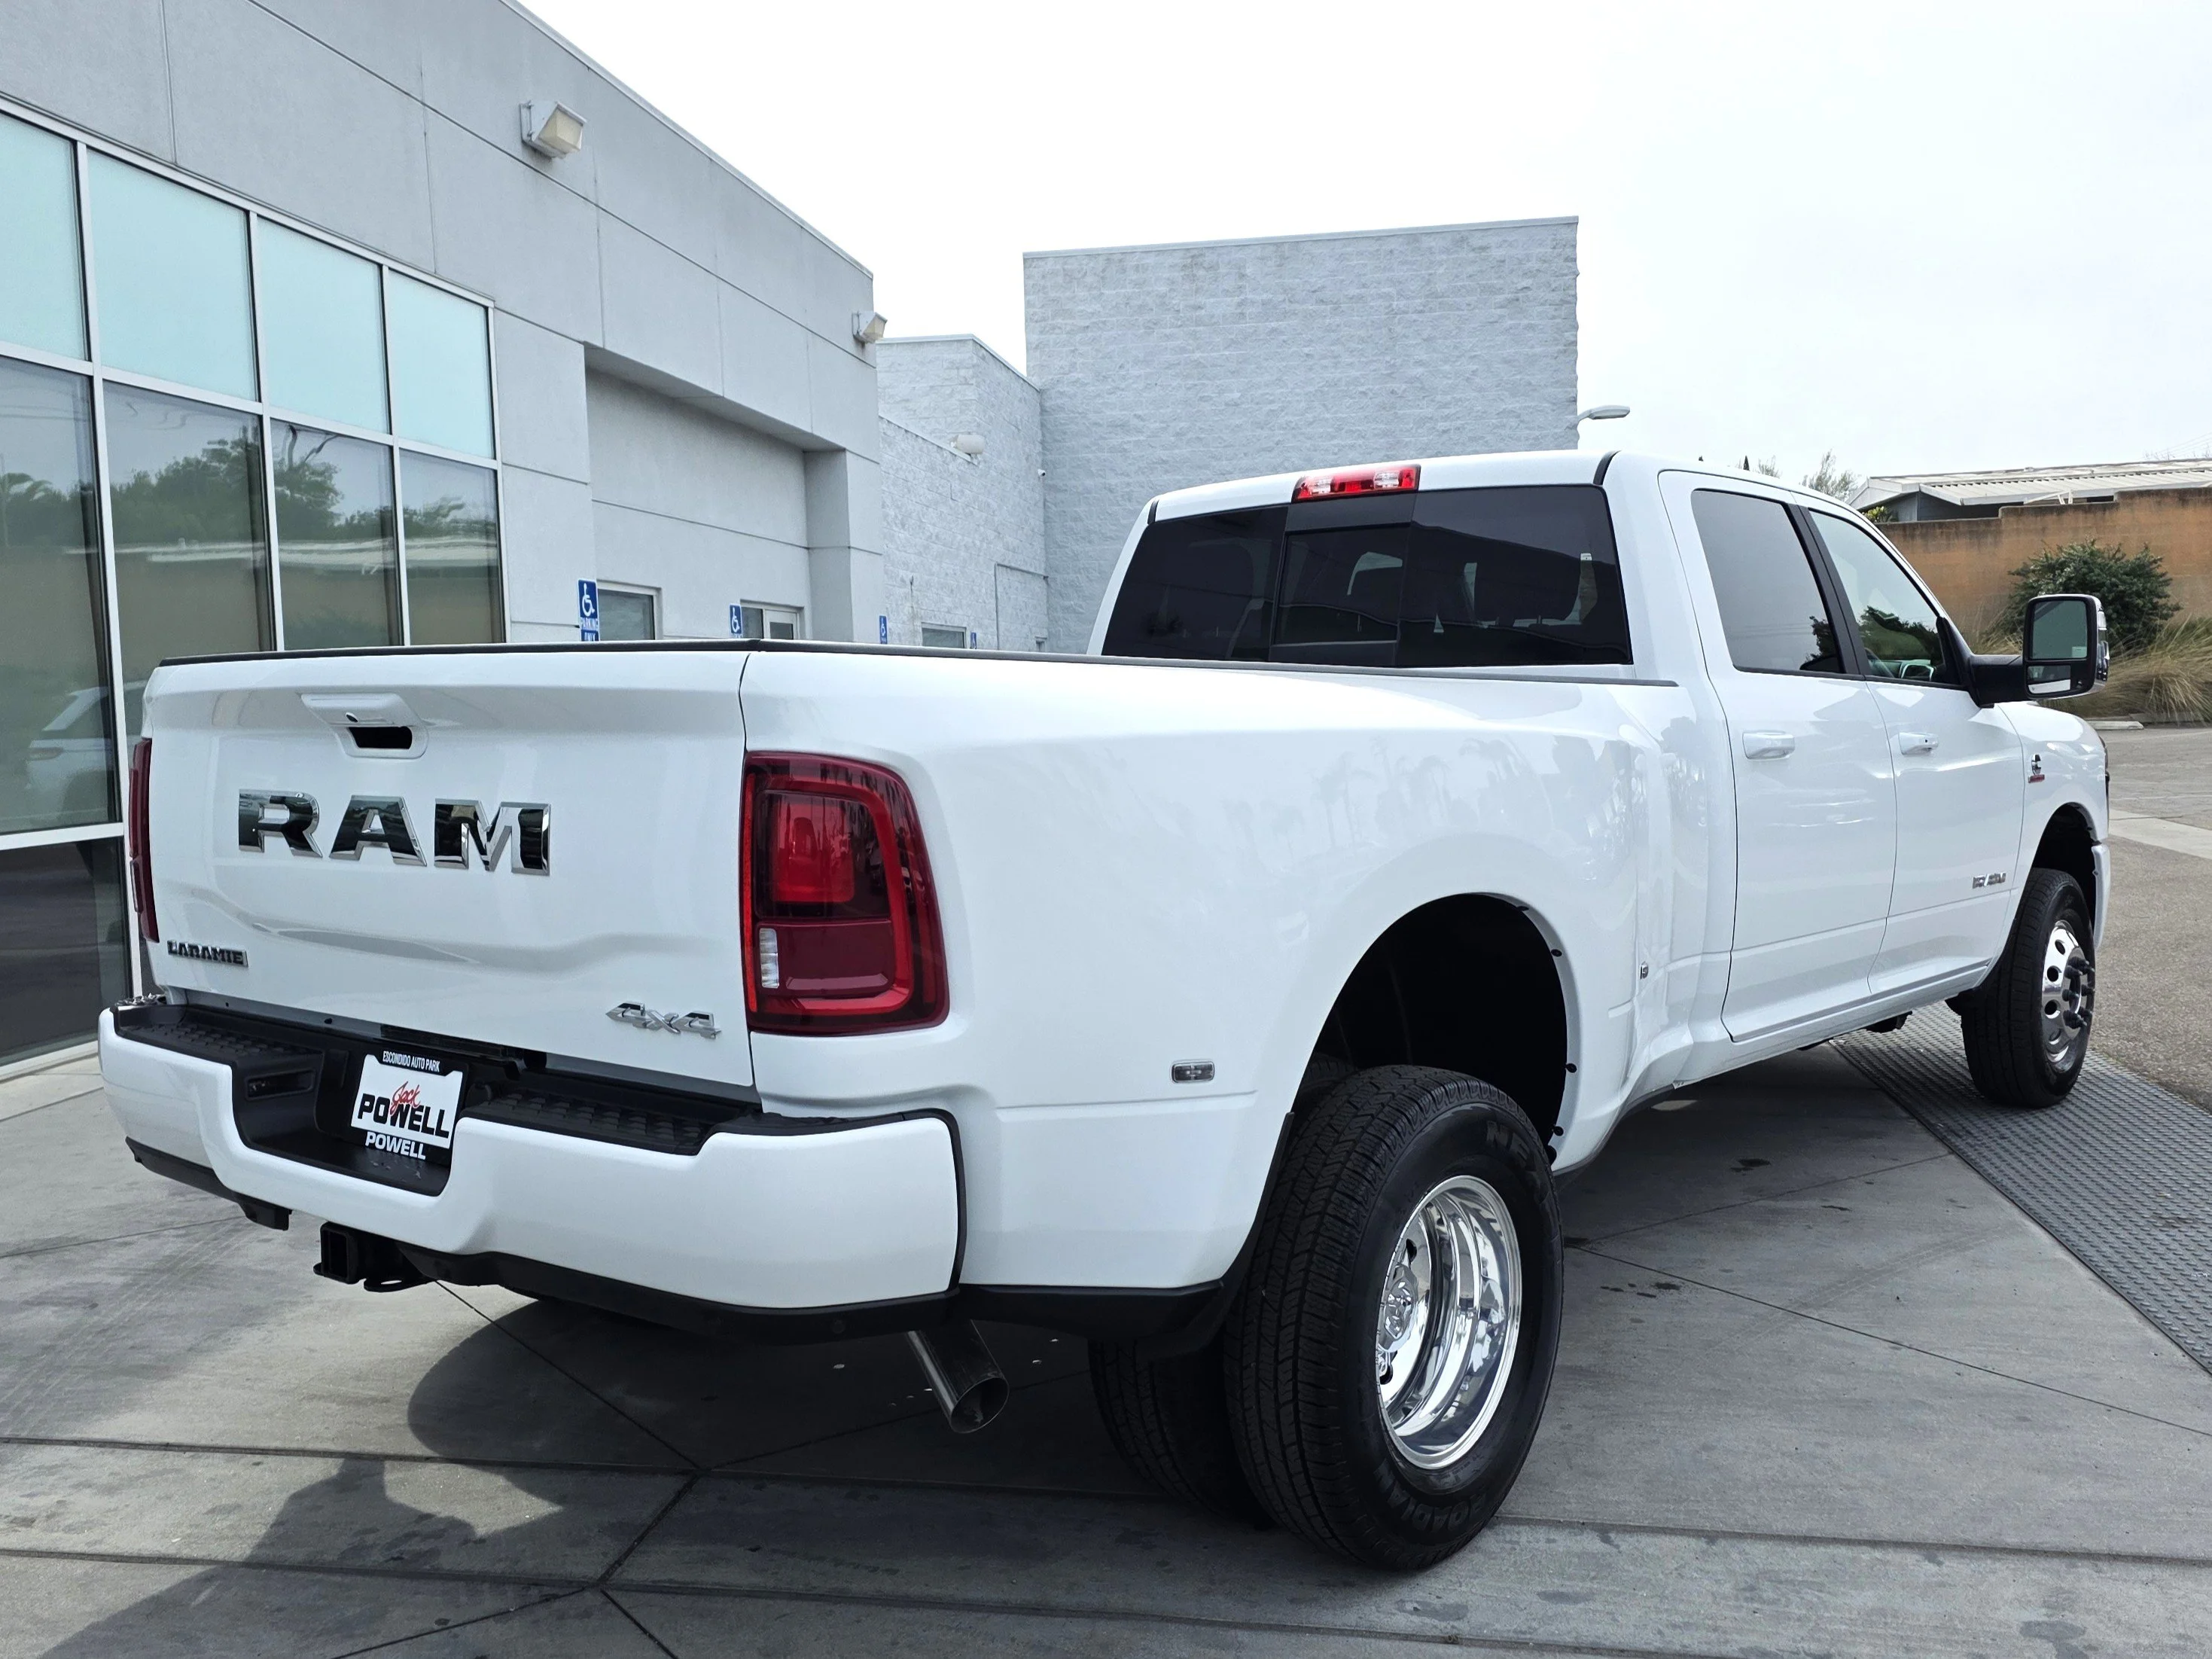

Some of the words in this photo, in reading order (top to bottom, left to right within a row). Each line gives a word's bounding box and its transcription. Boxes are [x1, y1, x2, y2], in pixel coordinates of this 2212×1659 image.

[238, 788, 551, 876] RAM
[166, 940, 248, 968] LARAMIE
[382, 1051, 411, 1067] ESCONDIDO
[411, 1056, 425, 1069] AUTO
[425, 1059, 440, 1072] PARK
[390, 1081, 421, 1115] Jack
[358, 1093, 449, 1139] POWELL
[365, 1131, 426, 1160] POWELL
